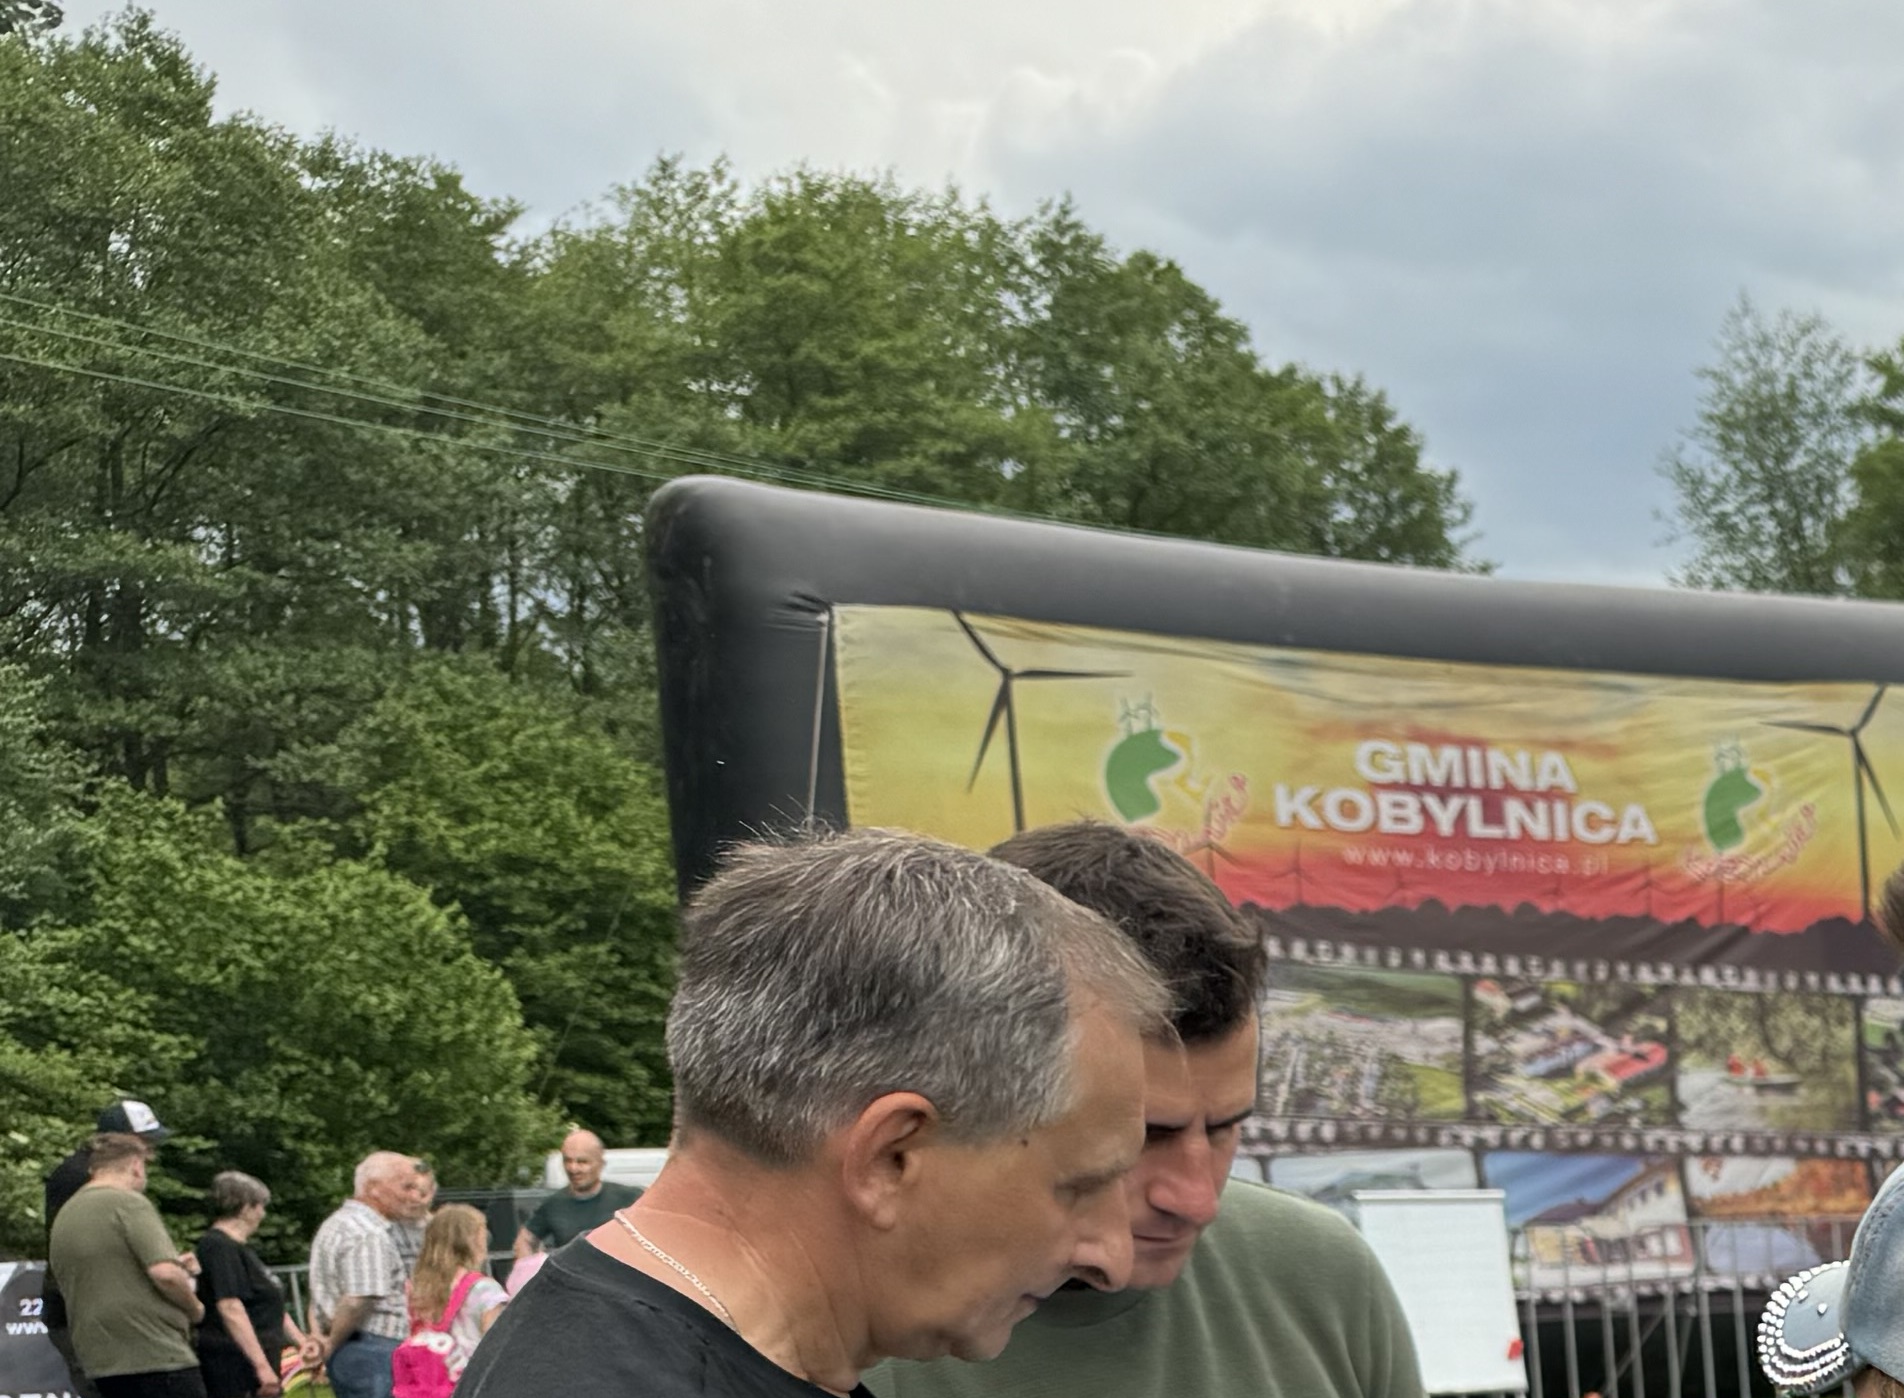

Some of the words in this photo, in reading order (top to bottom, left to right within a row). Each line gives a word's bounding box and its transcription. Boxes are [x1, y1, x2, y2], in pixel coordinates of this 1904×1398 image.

[1354, 738, 1578, 794] GMINA
[1273, 783, 1659, 845] KOBYLNICA
[1342, 845, 1609, 876] www.kobylnica.pl
